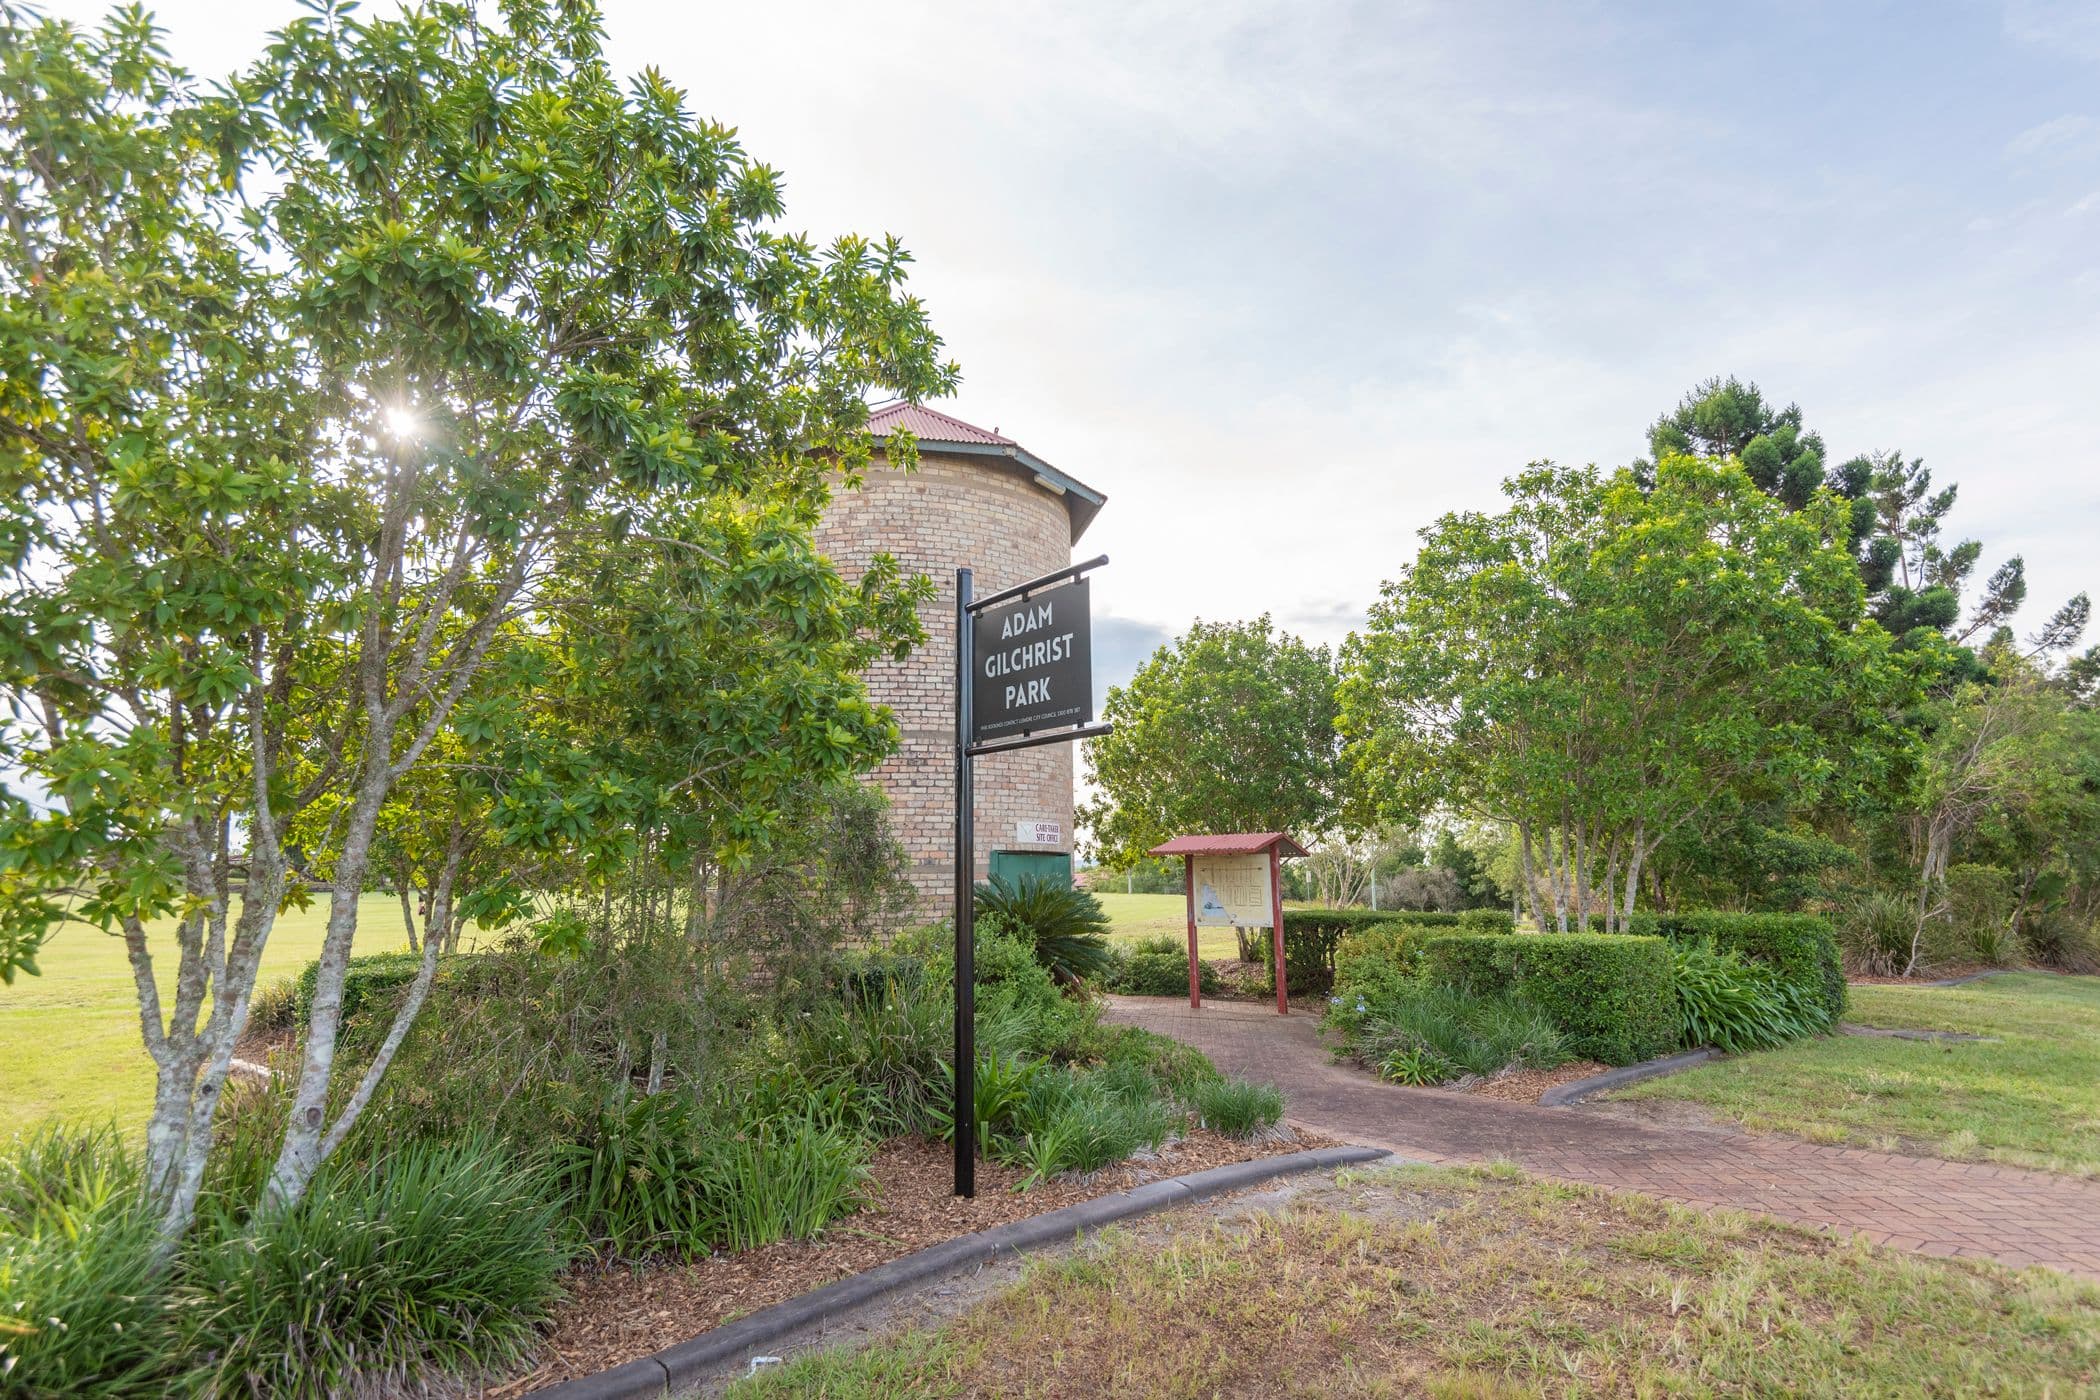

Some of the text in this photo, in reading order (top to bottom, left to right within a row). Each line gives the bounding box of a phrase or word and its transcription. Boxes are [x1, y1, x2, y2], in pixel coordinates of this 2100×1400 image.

[1001, 601, 1052, 640] ADAM
[985, 632, 1073, 678] GILCHRIST
[1005, 677, 1051, 709] PARK
[1036, 833, 1058, 843] SITE OFFICE
